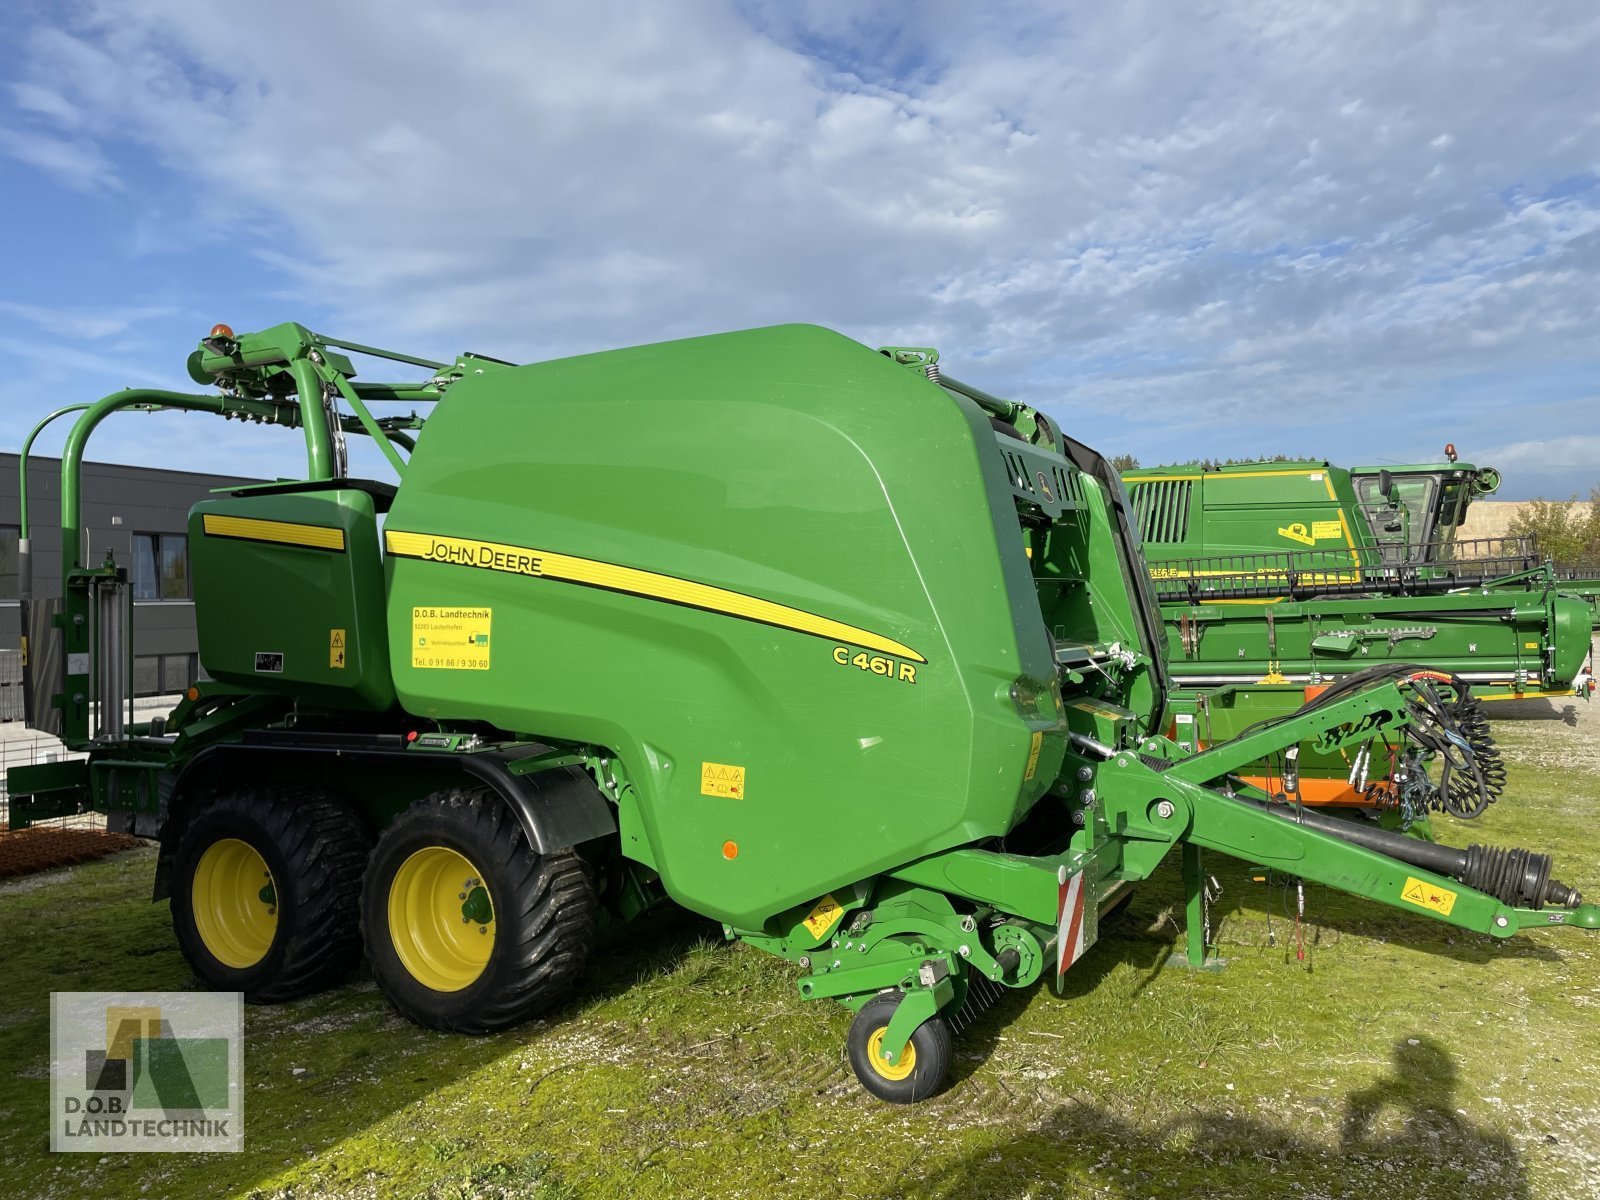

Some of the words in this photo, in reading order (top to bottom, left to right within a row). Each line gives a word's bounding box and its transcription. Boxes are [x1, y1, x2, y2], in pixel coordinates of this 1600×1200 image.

[425, 540, 475, 563] JOHN
[479, 546, 543, 573] DEERE
[414, 609, 438, 618] D.O.B.
[440, 609, 490, 619] Landtechnik
[415, 658, 427, 667] Tel.
[435, 658, 444, 667] 91
[468, 660, 477, 668] 30
[479, 660, 488, 668] 60
[832, 646, 849, 665] C
[852, 651, 895, 679] 461
[898, 661, 917, 684] R
